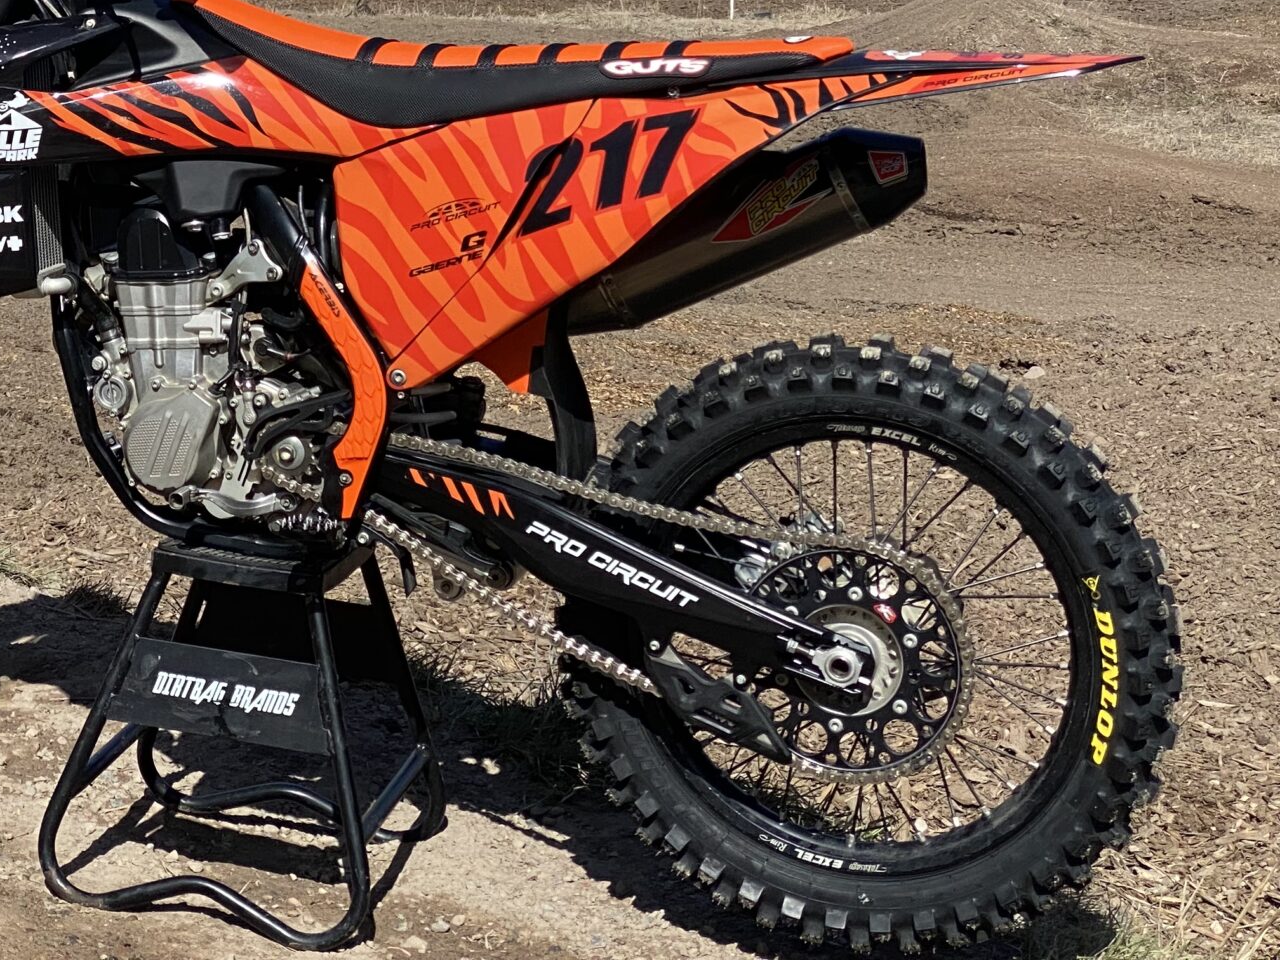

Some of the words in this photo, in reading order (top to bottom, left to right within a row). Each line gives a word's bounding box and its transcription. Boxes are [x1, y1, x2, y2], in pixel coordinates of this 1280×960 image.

[603, 58, 710, 76] GUTS
[923, 77, 959, 88] PRO
[962, 68, 1026, 83] CIRCUIT
[516, 107, 702, 239] 217
[410, 217, 441, 232] PRO
[445, 201, 501, 223] CIRCUIT
[871, 426, 922, 447] EXCEL
[525, 520, 588, 558] PRO
[587, 551, 700, 608] CIRCUIT
[152, 671, 228, 706] DIRTBAG
[229, 684, 300, 717] BRANDS
[1091, 608, 1120, 766] DUNLOP
[794, 848, 844, 870] EXCEL
